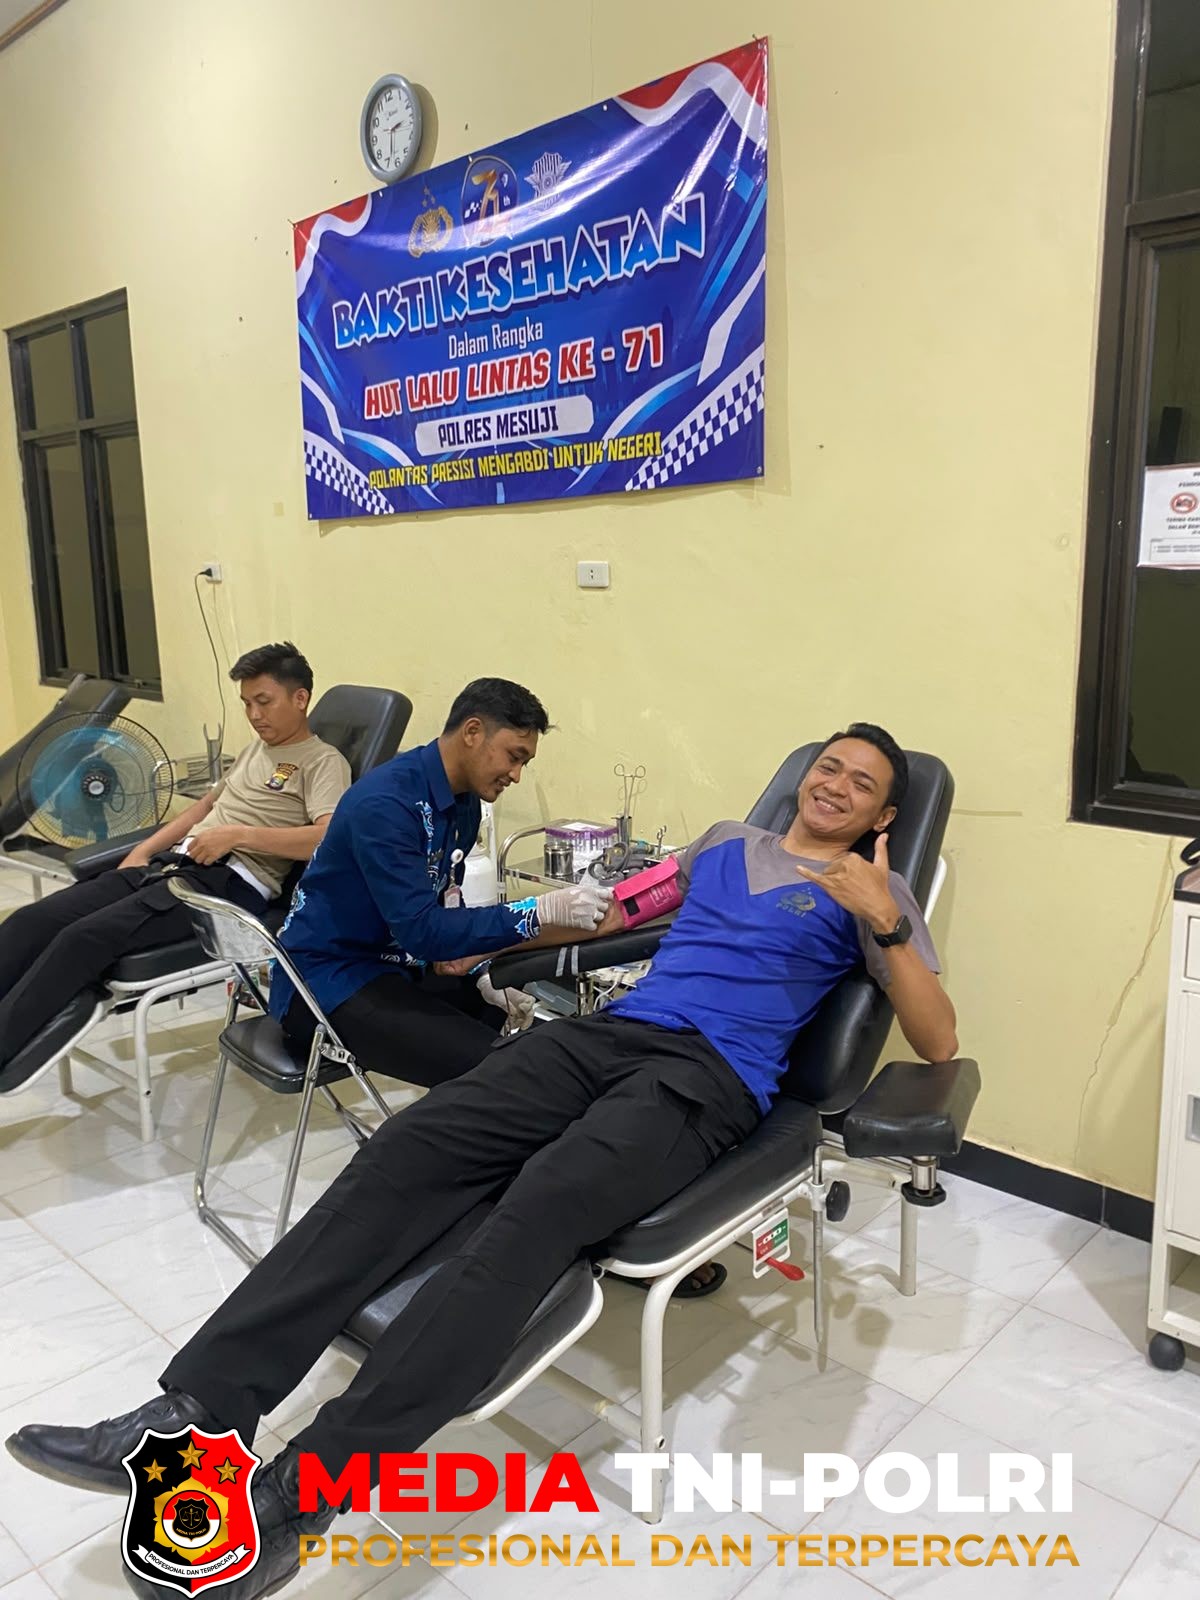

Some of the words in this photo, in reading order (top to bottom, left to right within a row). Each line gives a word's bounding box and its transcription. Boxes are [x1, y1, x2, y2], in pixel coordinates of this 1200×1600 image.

[384, 89, 393, 103] 12
[377, 101, 384, 113] 11
[372, 136, 378, 146] 9
[376, 149, 383, 160] 8
[384, 157, 391, 169] 7
[394, 157, 401, 168] 6
[333, 276, 437, 349] BAKTI
[436, 192, 705, 322] KESEHATAN
[449, 331, 489, 360] Dalam
[492, 317, 543, 349] Rangka
[365, 379, 403, 421] HUT
[405, 367, 460, 413] LALU
[466, 348, 551, 401] LINTAS
[558, 336, 596, 384] KE
[622, 323, 663, 372] 71
[438, 416, 491, 448] POLRES
[496, 406, 559, 439] MESUJI
[369, 465, 429, 491] POLANTAS
[431, 457, 475, 484] PRESISI
[477, 447, 550, 477] MENGABDI
[552, 440, 605, 469] UNTUK
[607, 431, 662, 462] NEGERI
